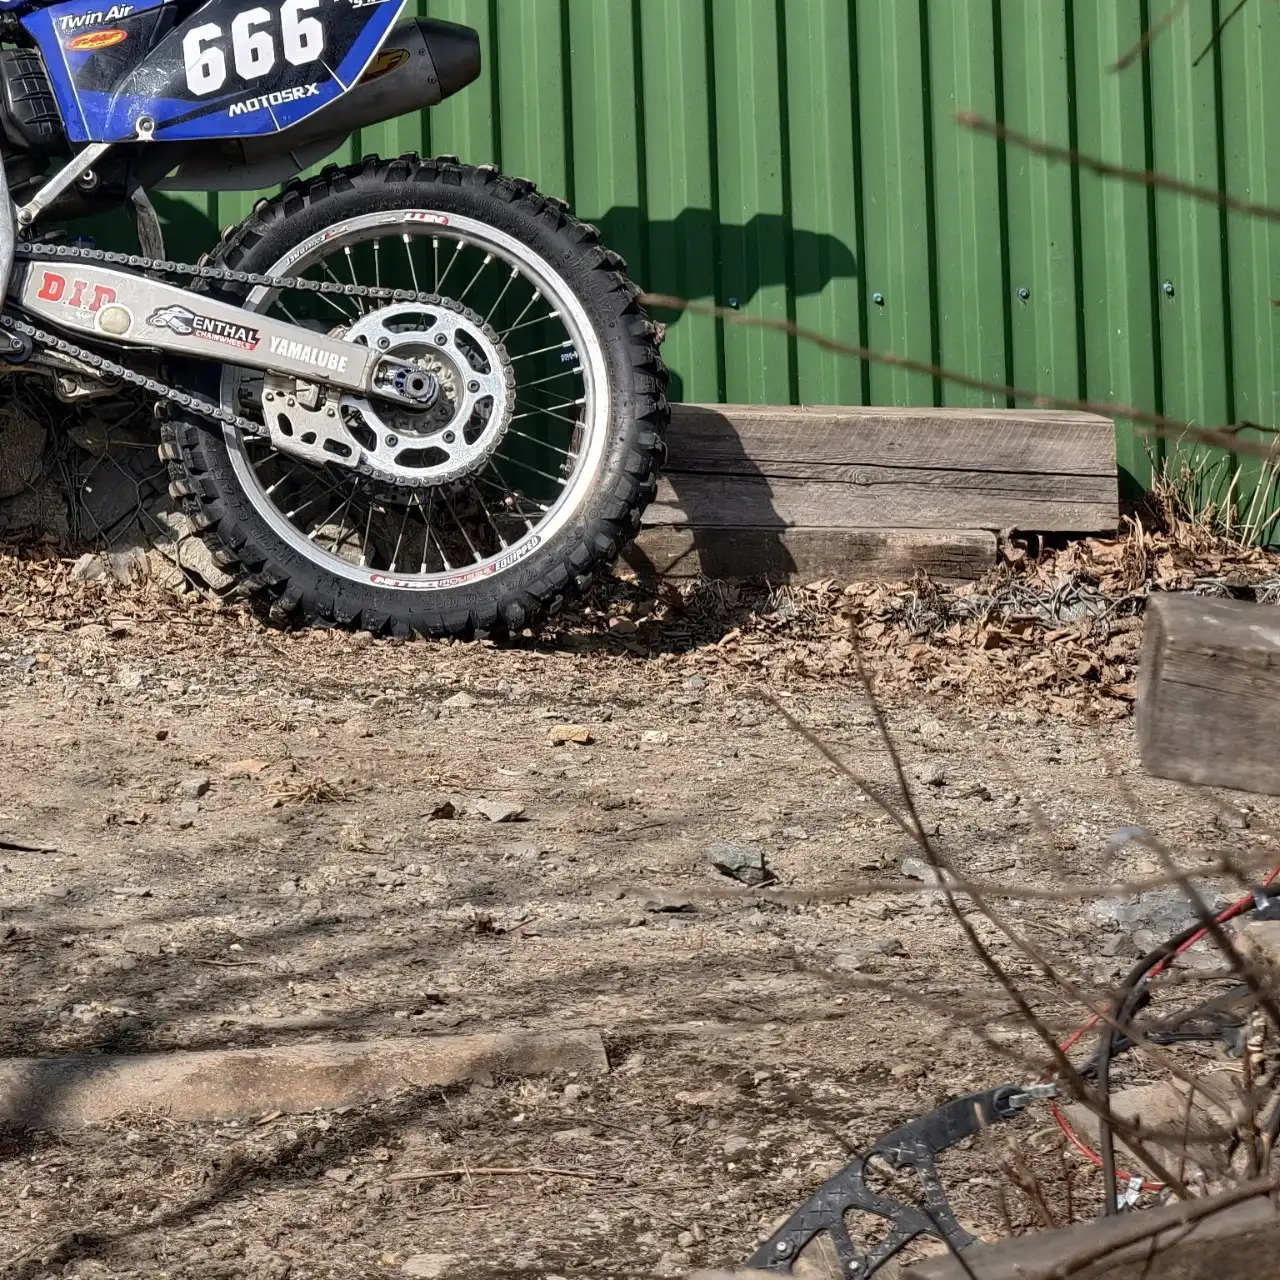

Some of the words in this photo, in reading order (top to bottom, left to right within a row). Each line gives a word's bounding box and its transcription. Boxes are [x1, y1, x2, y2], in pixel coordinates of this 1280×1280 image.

[59, 11, 103, 30] Twin
[105, 3, 134, 21] Air
[228, 82, 320, 117] MOTOSRX
[269, 335, 348, 374] YAMALUBE
[495, 535, 540, 572] EQUIPPED
